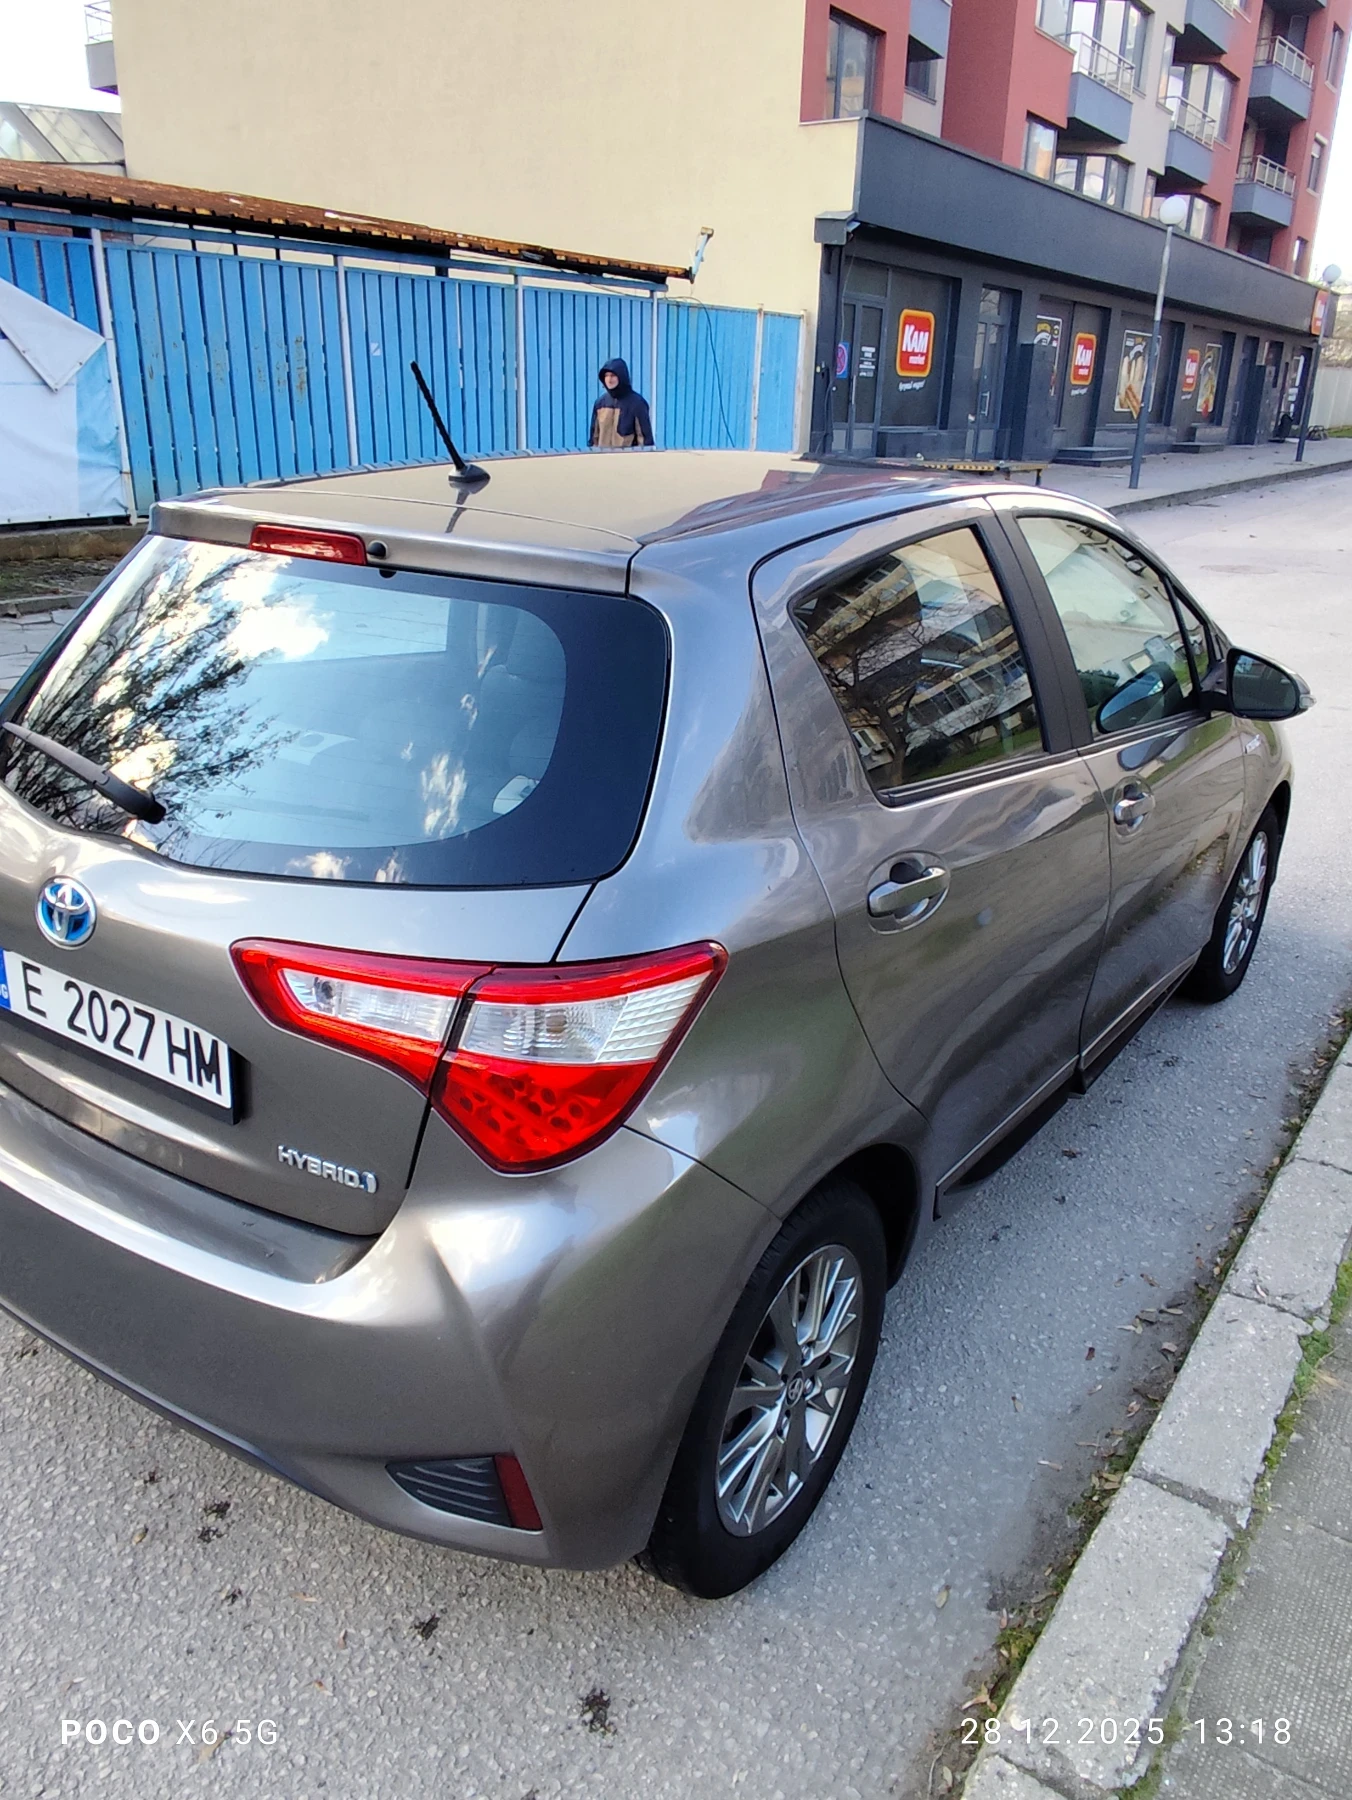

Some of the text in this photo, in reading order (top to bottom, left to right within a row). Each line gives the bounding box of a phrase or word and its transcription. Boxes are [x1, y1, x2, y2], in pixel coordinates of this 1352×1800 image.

[902, 324, 929, 353] KAM
[0, 983, 9, 999] G
[21, 960, 222, 1096] E 2027 HM
[278, 1145, 360, 1188] HYBRID
